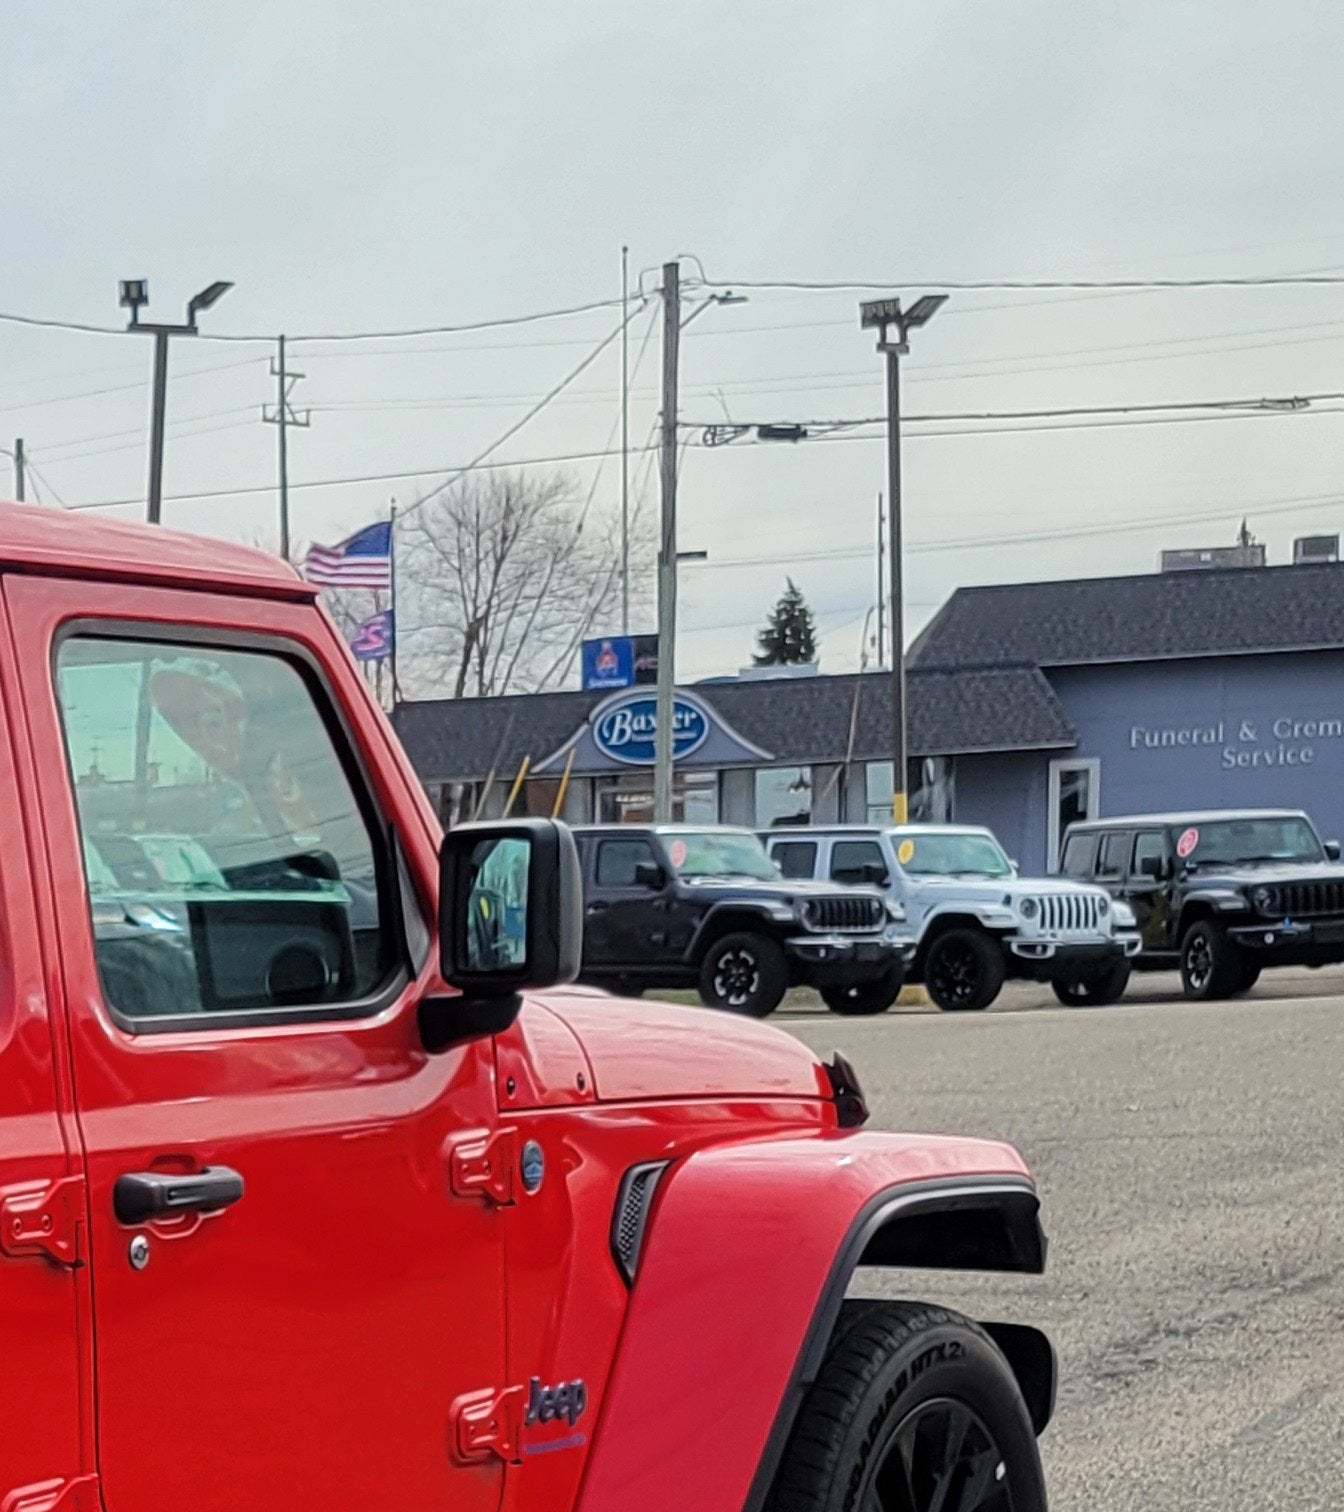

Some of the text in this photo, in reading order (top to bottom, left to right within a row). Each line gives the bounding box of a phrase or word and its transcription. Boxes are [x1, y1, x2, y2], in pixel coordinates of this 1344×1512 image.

[602, 708, 697, 746] Baxer
[1130, 721, 1224, 749] Funeral
[1239, 719, 1257, 741] &
[1221, 745, 1314, 770] Service
[523, 1375, 587, 1428] Jeep
